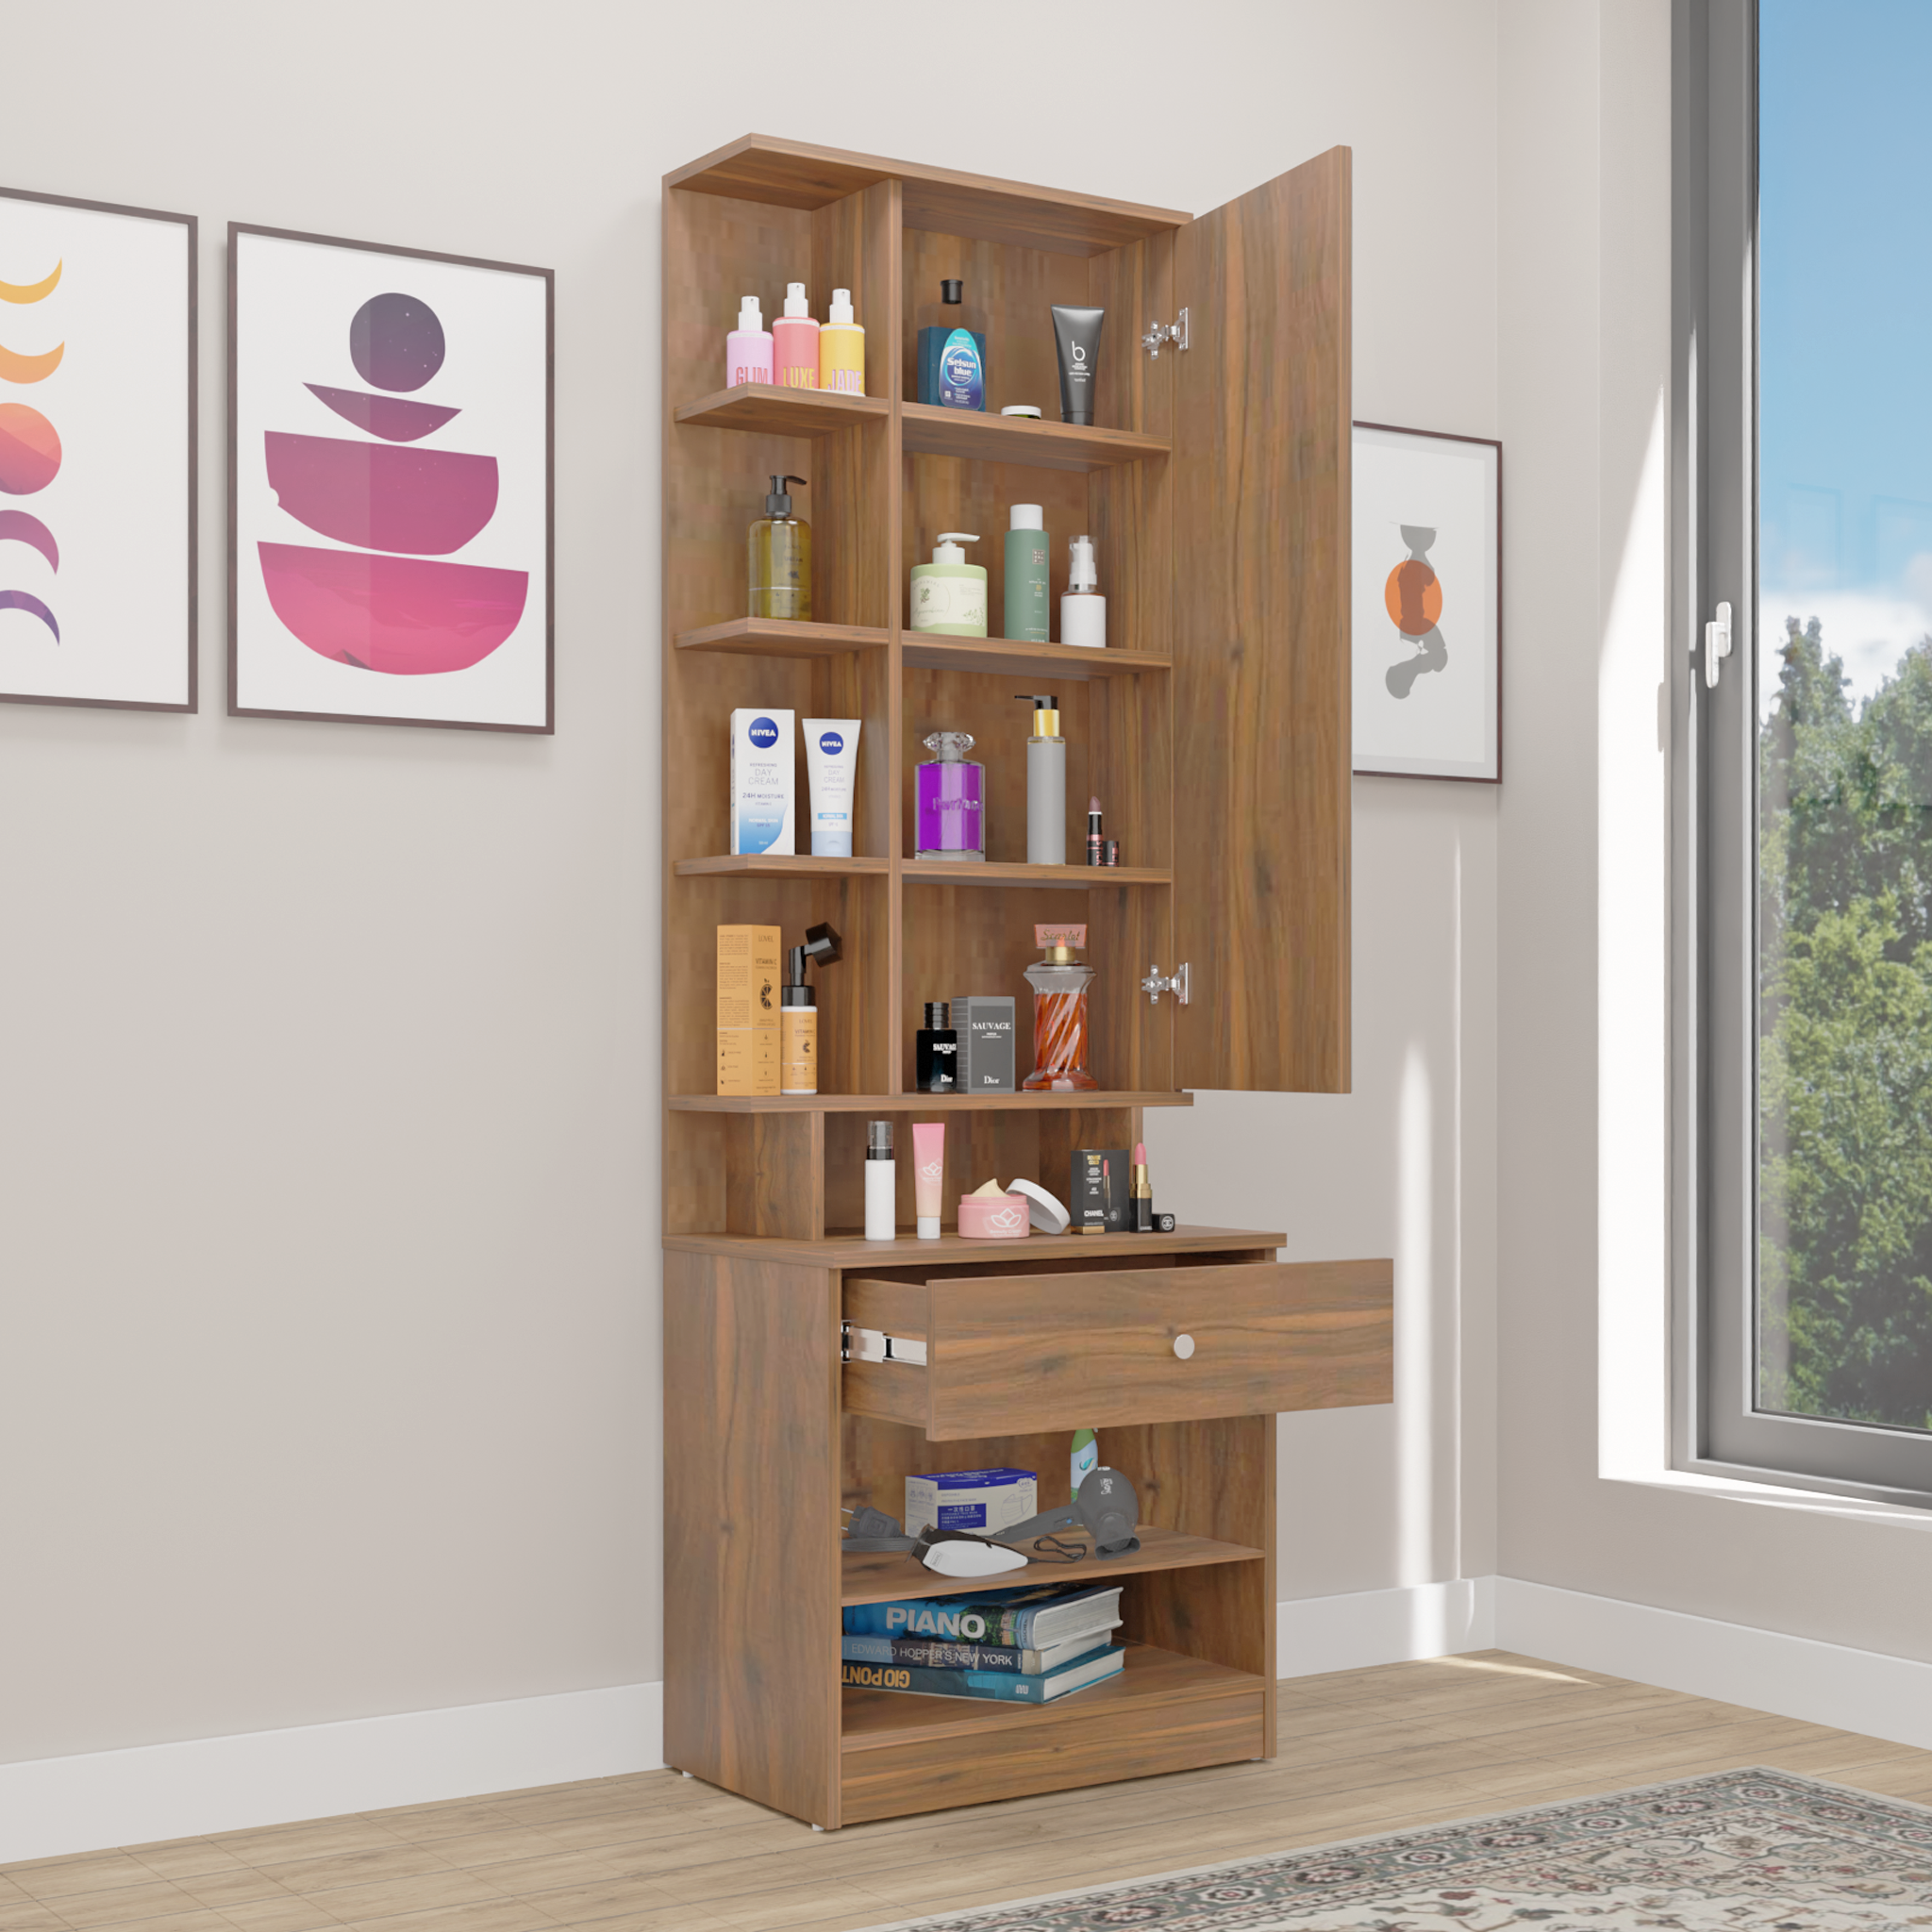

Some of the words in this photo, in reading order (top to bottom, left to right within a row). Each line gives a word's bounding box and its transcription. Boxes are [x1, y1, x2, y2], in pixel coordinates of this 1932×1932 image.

[946, 358, 976, 369] Selsun
[954, 367, 973, 376] blue
[783, 366, 815, 389] LUXE
[827, 369, 861, 392] JADE
[755, 768, 773, 776] DAY
[748, 776, 779, 786] CREAM
[972, 1022, 1011, 1030] SAUVAGE
[984, 1075, 1000, 1084] Dior
[886, 1607, 986, 1640] PIANO
[851, 1643, 897, 1657] EDWARD
[899, 1648, 953, 1661] HOPPER'S
[955, 1652, 979, 1663] NEW
[982, 1654, 1012, 1666] YORK
[884, 1669, 910, 1689] GIO
